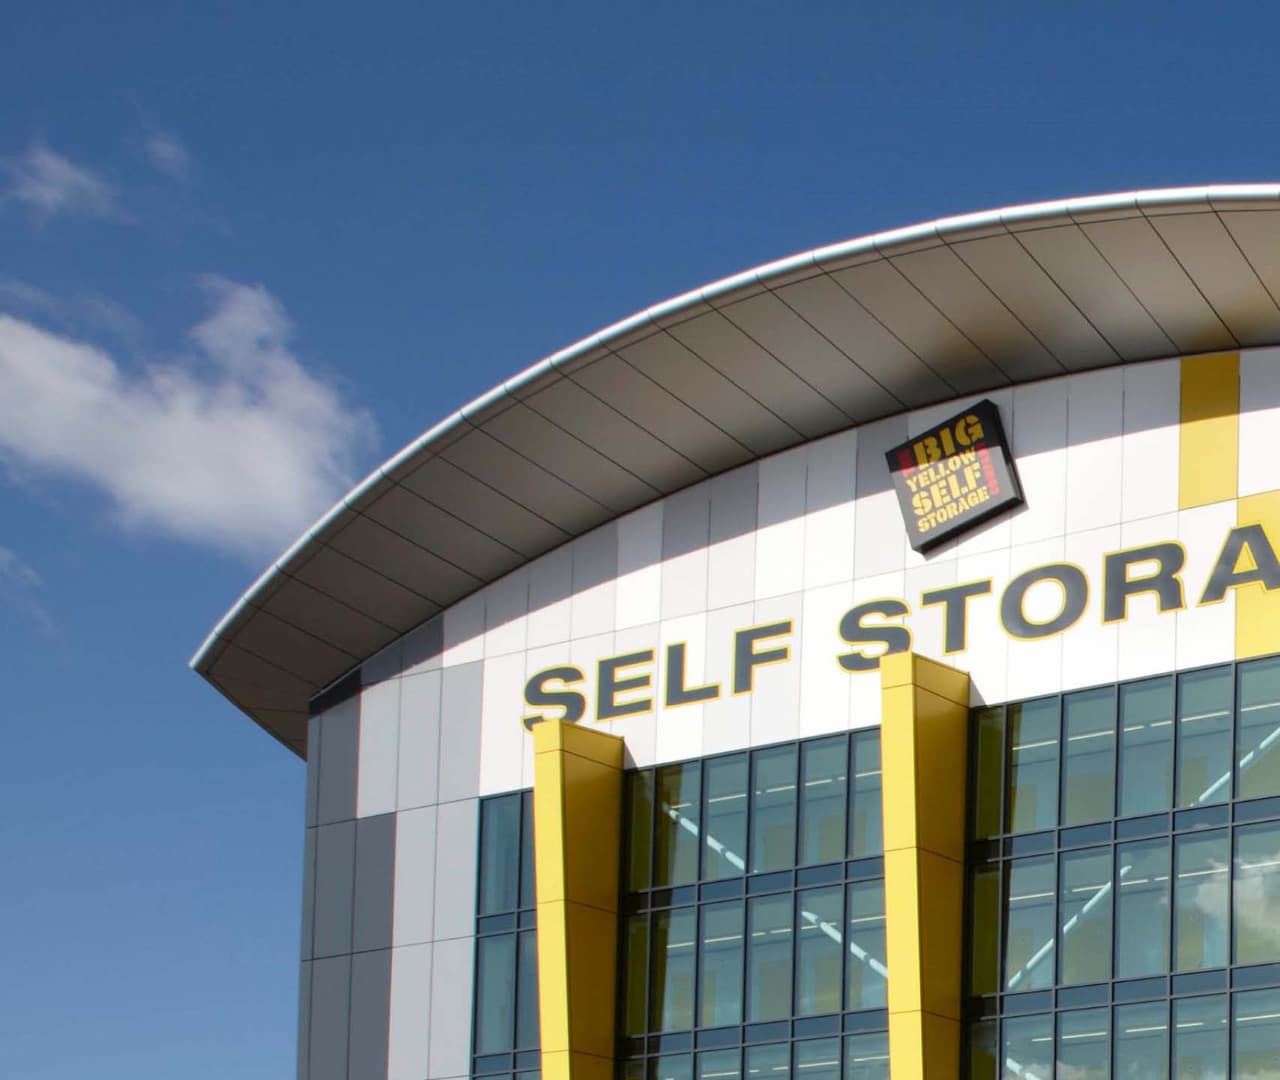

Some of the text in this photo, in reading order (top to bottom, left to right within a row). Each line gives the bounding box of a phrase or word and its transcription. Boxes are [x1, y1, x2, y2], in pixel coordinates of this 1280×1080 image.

[912, 415, 984, 469] BIG
[906, 447, 976, 492] YELLOW
[912, 462, 981, 516] SELF
[918, 486, 990, 533] STORAGE
[521, 617, 794, 734] SELF
